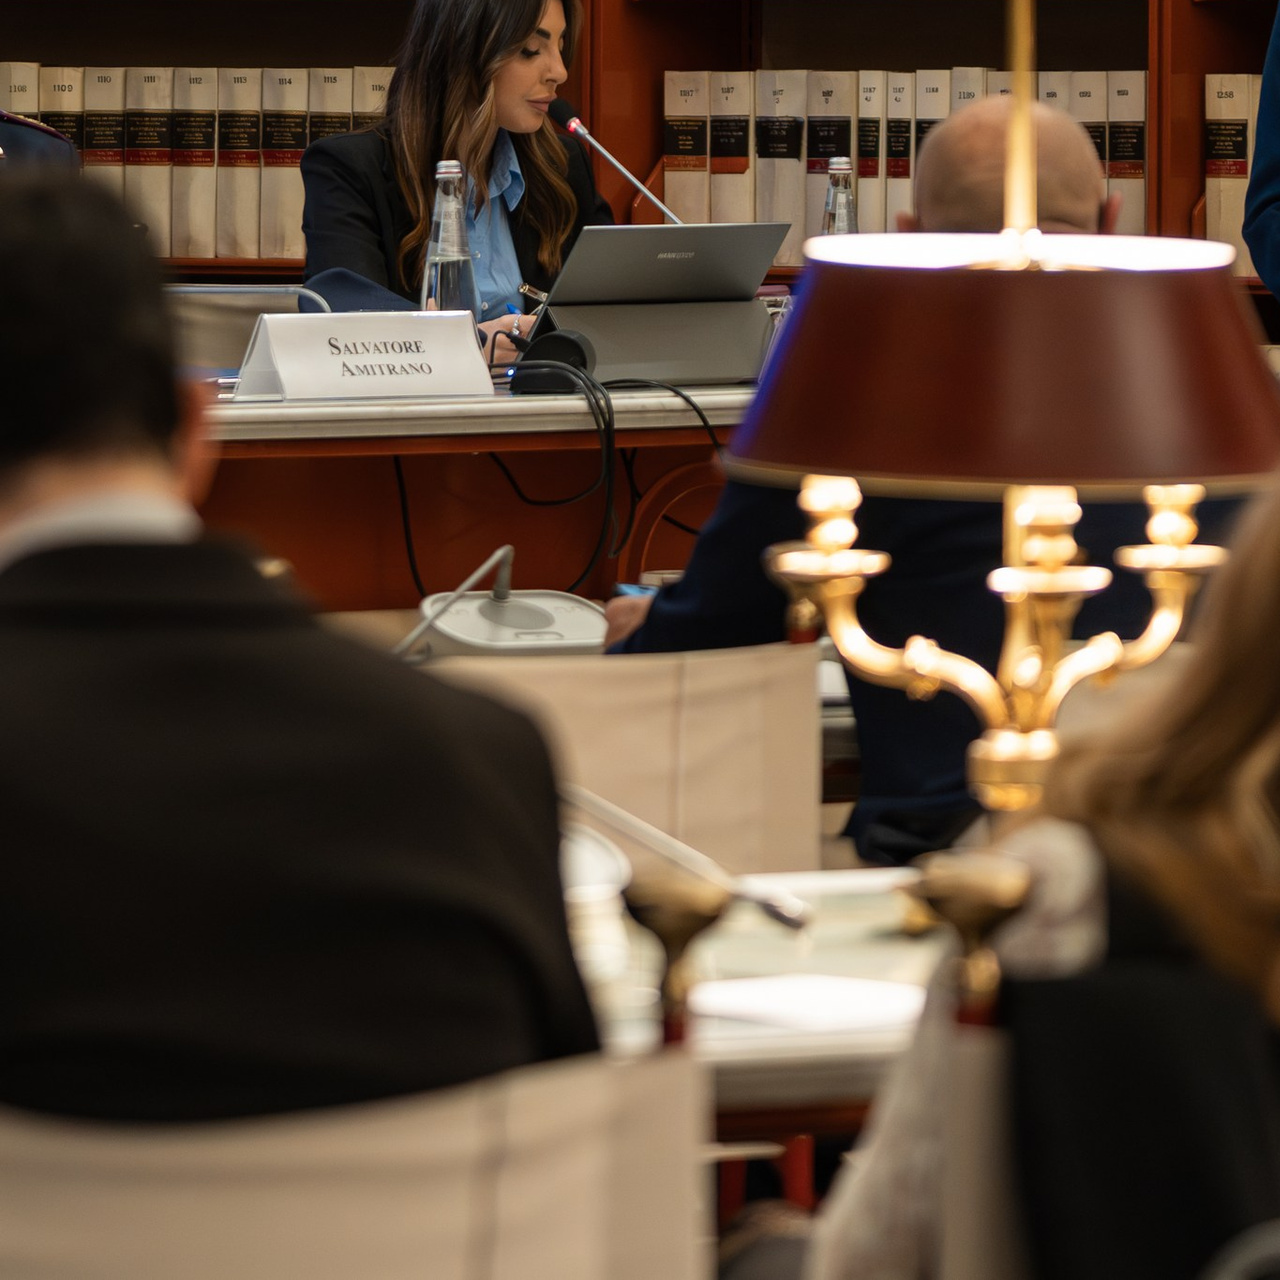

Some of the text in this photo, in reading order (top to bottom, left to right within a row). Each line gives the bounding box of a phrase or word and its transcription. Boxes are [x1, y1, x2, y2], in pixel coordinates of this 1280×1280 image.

[98, 76, 112, 84] 1110
[144, 76, 156, 84] 1111
[189, 77, 203, 85] 1112
[279, 78, 293, 86] 1114
[324, 76, 338, 84] 1115
[9, 85, 28, 94] 1108
[54, 85, 74, 93] 1109
[1217, 91, 1235, 99] 1258
[328, 336, 425, 356] SALVATORE
[341, 360, 433, 377] AMITRANO
